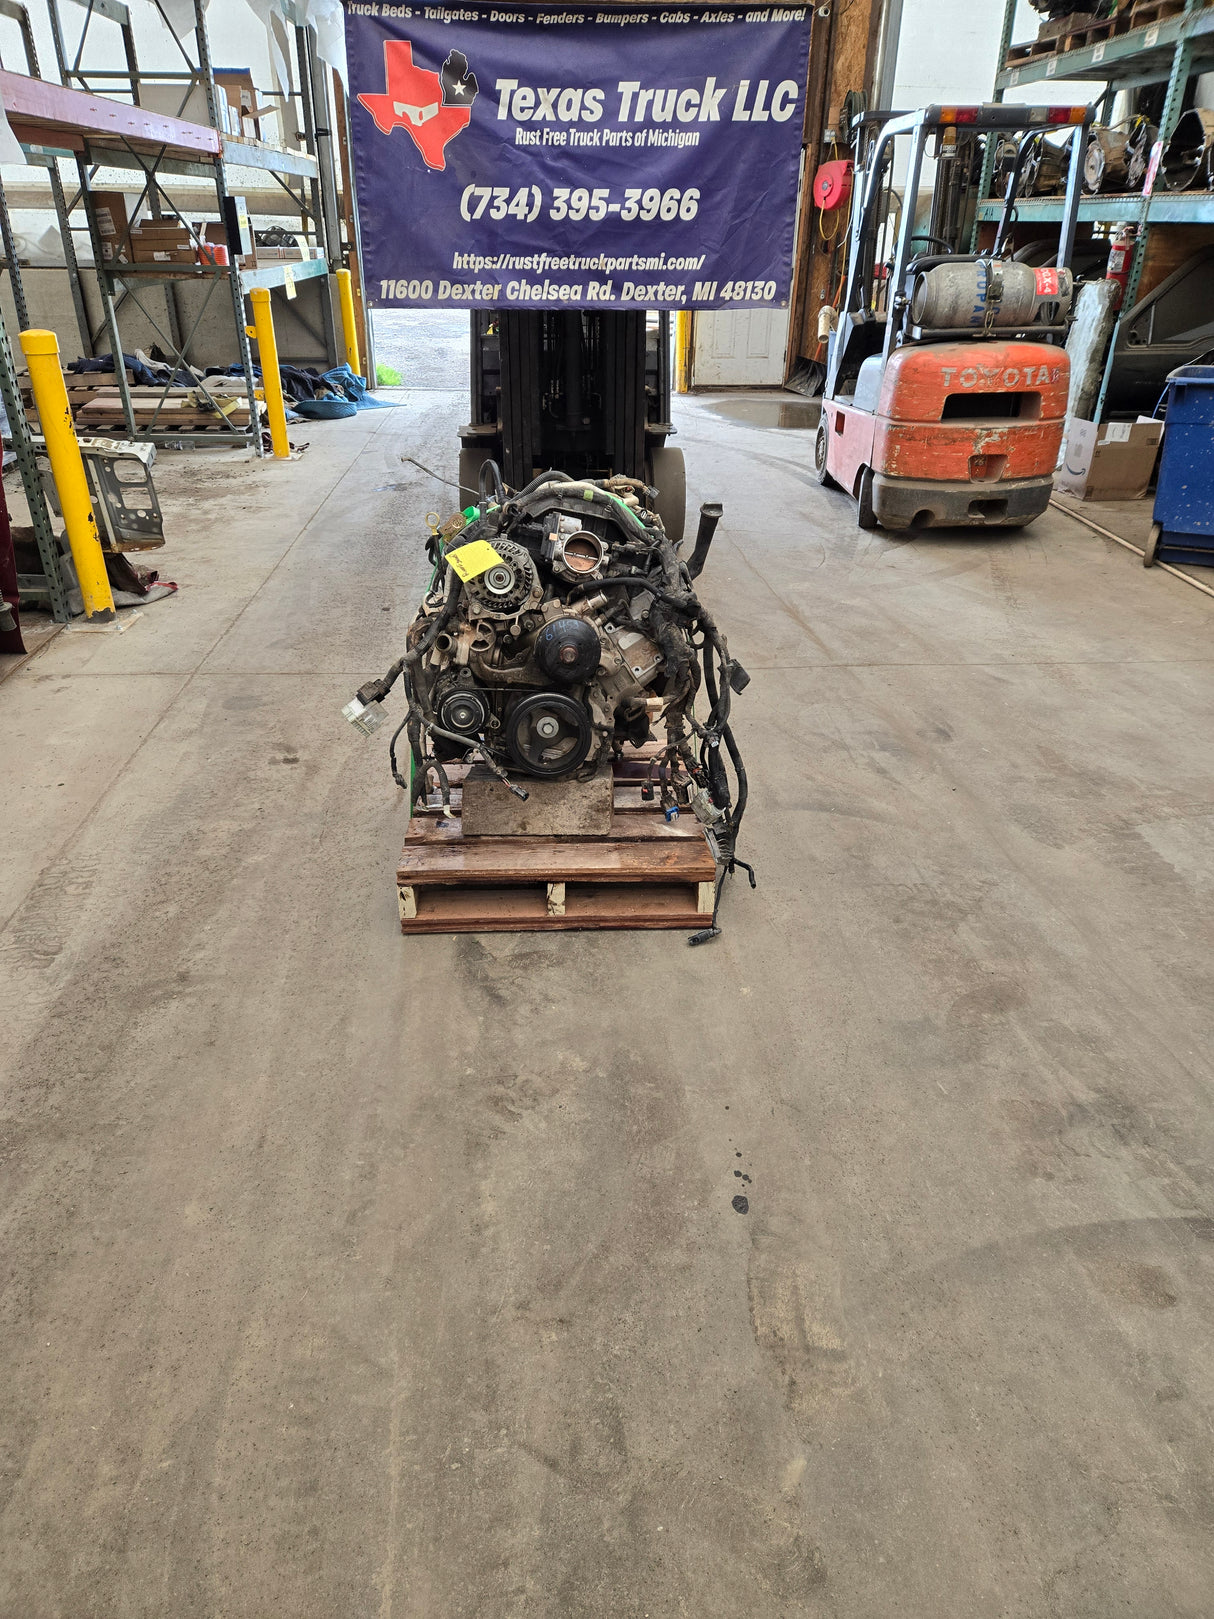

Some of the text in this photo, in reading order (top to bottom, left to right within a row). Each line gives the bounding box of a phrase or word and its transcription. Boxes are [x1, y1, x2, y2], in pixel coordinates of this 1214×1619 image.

[347, 1, 379, 16] Truck
[381, 4, 413, 18] Beds
[424, 7, 479, 23] Tailgates
[490, 10, 525, 23] Doors
[536, 13, 585, 24] Fenders
[595, 13, 649, 26] Bumpers
[660, 11, 690, 23] Cabs
[700, 11, 735, 23] Axles
[745, 9, 768, 22] and
[771, 8, 806, 22] More!
[495, 77, 799, 122] Texas Truck LLC
[515, 128, 700, 148] Rust Free Truck Parts of Michigan
[460, 184, 700, 222] (734) 395-3966
[453, 252, 706, 275] https://rustfreetruckpartsmi.com/
[380, 279, 777, 304] 11600 Dexter Chelsea Rd. Dexter, MI 48130
[940, 365, 1050, 388] TOYOTA
